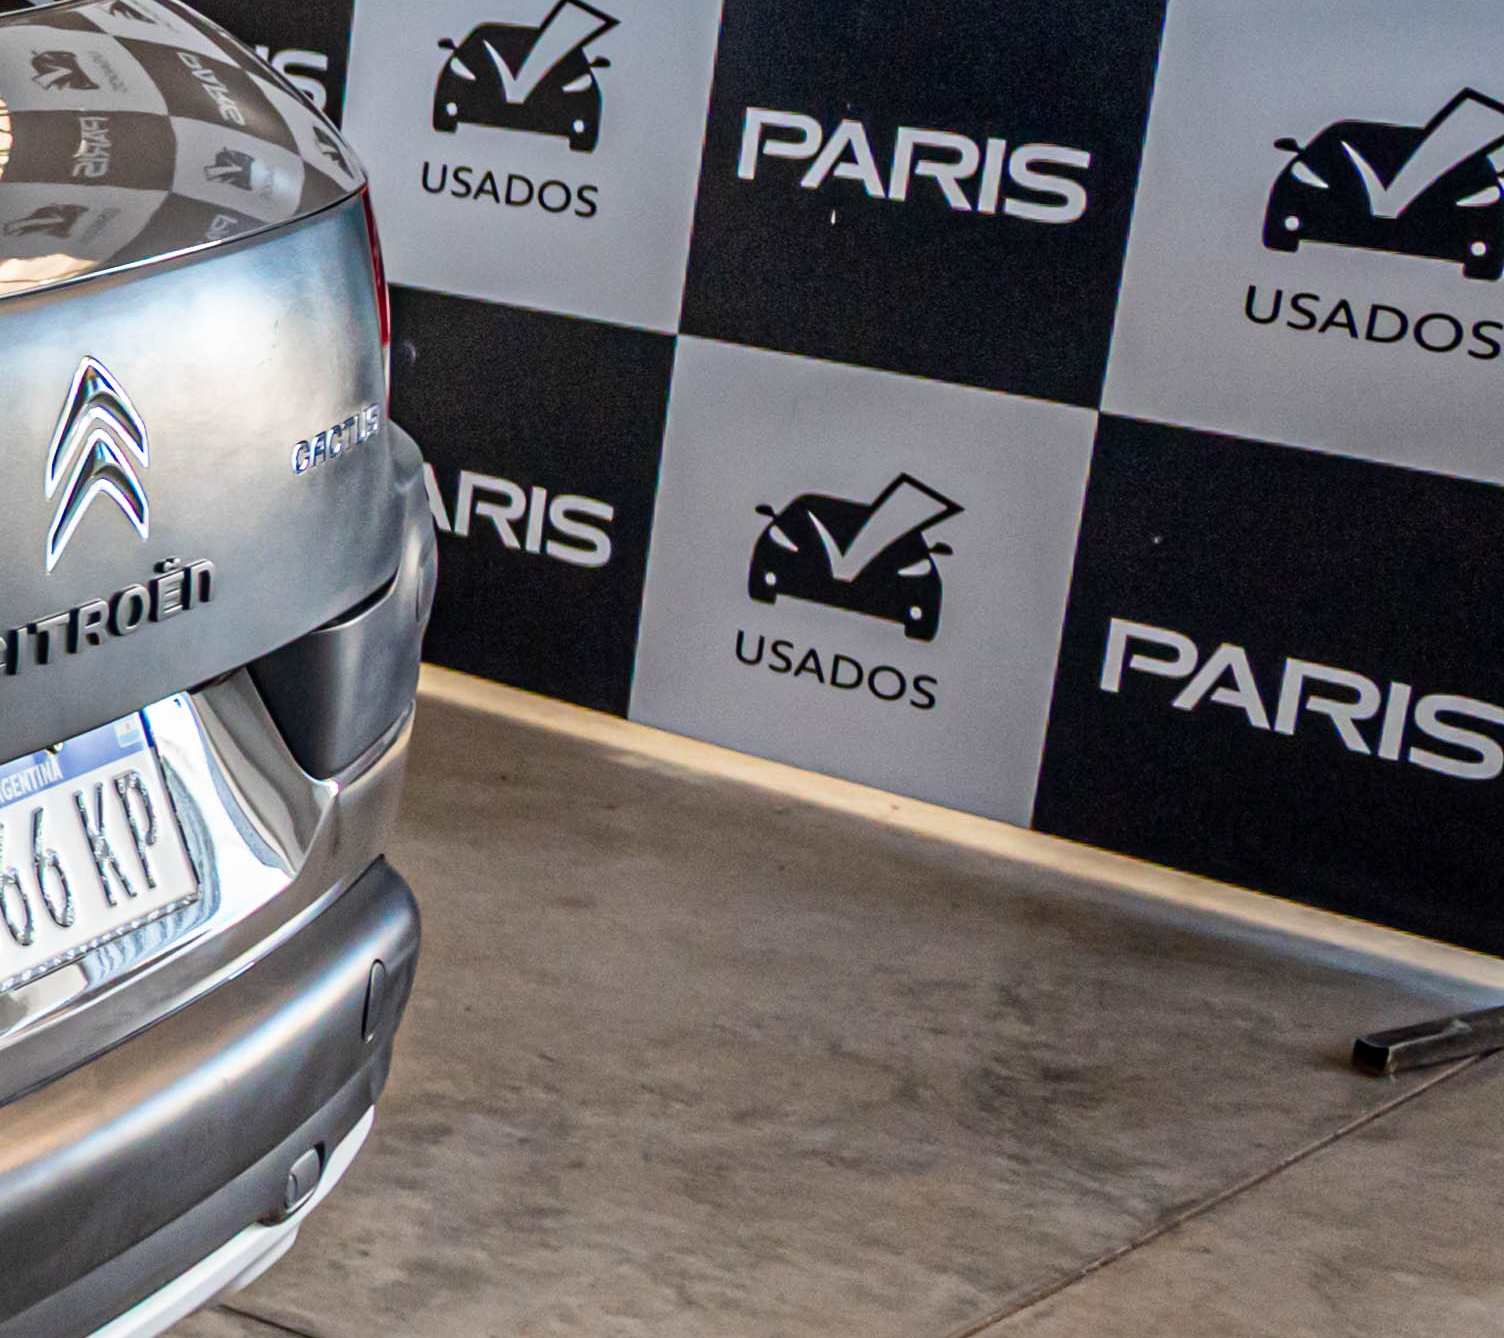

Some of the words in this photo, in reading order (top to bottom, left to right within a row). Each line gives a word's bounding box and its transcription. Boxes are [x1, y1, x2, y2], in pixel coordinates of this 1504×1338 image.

[421, 161, 599, 219] USADOS
[738, 106, 1090, 224] PARIS
[1245, 285, 1504, 360] USADOS
[735, 630, 939, 710] USADOS
[1100, 618, 1504, 780] PARIS
[74, 769, 159, 909] KP
